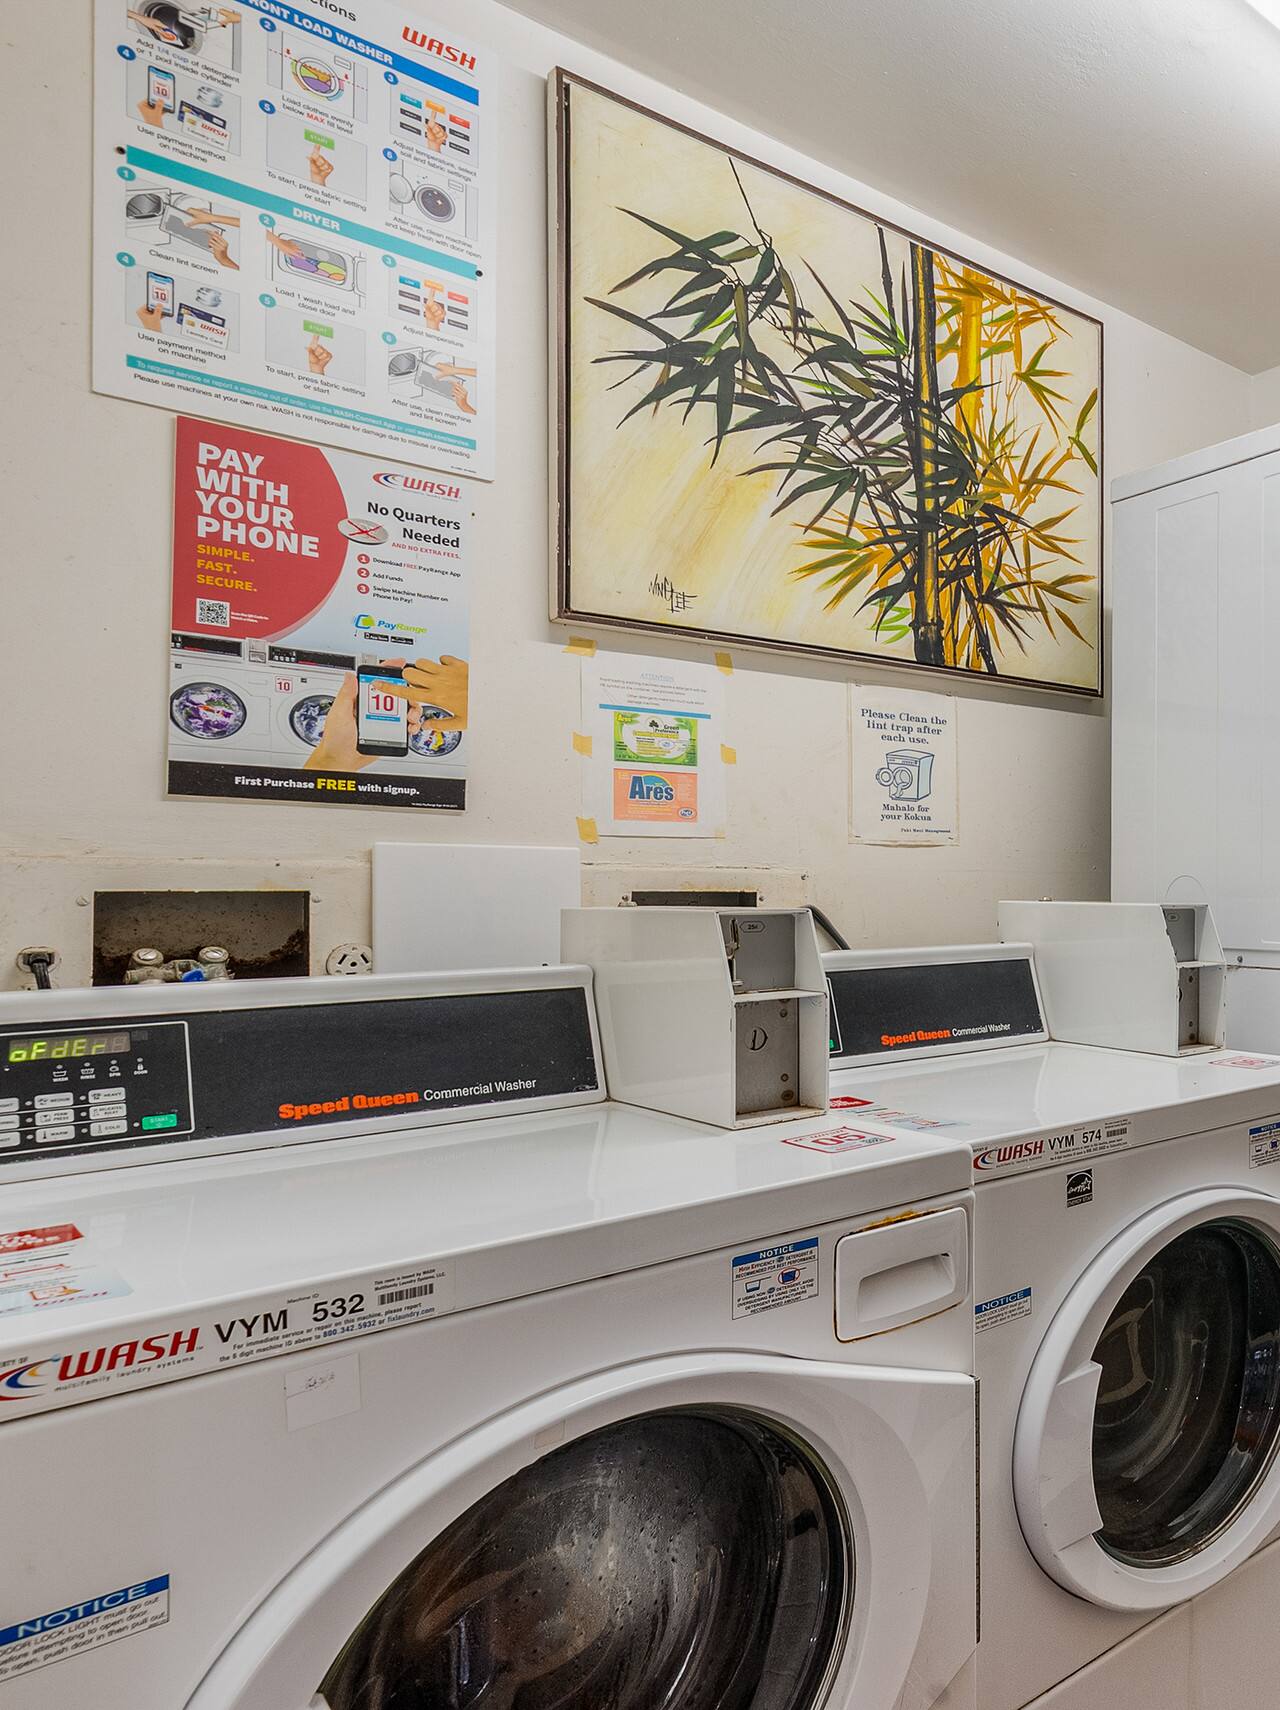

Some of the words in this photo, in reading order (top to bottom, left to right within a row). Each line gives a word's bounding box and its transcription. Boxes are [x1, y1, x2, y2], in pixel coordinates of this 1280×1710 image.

[249, 0, 290, 19] RONT
[293, 14, 332, 37] LOAD
[336, 31, 393, 65] WASHER
[402, 26, 476, 70] WASH
[200, 71, 232, 88] cylinder
[201, 62, 240, 83] detergent
[306, 112, 325, 124] MAX
[137, 125, 155, 137] Use
[157, 132, 192, 151] payment
[195, 145, 226, 161] method
[172, 146, 208, 163] machine
[321, 189, 340, 201] fabric
[343, 198, 367, 212] setting
[293, 207, 340, 231] DRYER
[149, 249, 174, 262] Clean
[191, 262, 219, 275] screen
[275, 287, 295, 299] Load
[138, 332, 155, 342] Use
[157, 338, 193, 354] payment
[195, 347, 226, 361] method
[403, 325, 422, 337] Adjust
[423, 331, 464, 348] temperature
[171, 350, 207, 364] machine
[297, 375, 319, 387] press
[320, 378, 340, 391] fabric
[341, 385, 366, 398] setting
[314, 385, 330, 395] start
[134, 373, 160, 385] Please
[177, 384, 212, 398] machines
[222, 395, 238, 405] your
[240, 400, 255, 408] own
[271, 405, 294, 417] WASH
[314, 417, 350, 431] responsible
[361, 428, 389, 440] damage
[408, 438, 429, 449] misuse
[392, 398, 408, 408] After
[425, 407, 443, 417] clean
[444, 412, 472, 424] machine
[435, 418, 457, 428] screen
[198, 441, 265, 476] PAY
[195, 466, 289, 506] WITH
[403, 476, 460, 499] WASH
[195, 490, 295, 531] YOUR
[367, 501, 389, 516] No
[393, 507, 461, 530] Quarters
[197, 515, 320, 559] PHONE
[402, 527, 460, 549] Needed
[196, 543, 255, 563] SIMPLE.
[391, 542, 406, 550] AND
[420, 547, 442, 557] EXTRA
[196, 559, 237, 574] FAST.
[373, 557, 403, 568] Download
[418, 565, 449, 576] PayRange
[196, 574, 257, 592] SECURE.
[385, 574, 404, 583] Funds
[373, 585, 391, 595] Swipe
[392, 588, 416, 598] Machine
[417, 592, 440, 602] Number
[373, 593, 392, 601] Phone
[378, 620, 428, 634] PayRange
[277, 680, 290, 692] 10
[371, 694, 395, 712] 10
[861, 708, 896, 720] Please
[900, 712, 927, 724] Clean
[931, 716, 947, 725] the
[866, 720, 887, 730] lint
[891, 723, 913, 735] trap
[917, 726, 942, 735] after
[881, 734, 906, 743] each
[909, 736, 929, 745] use.
[234, 776, 262, 787] First
[263, 778, 314, 790] Purchase
[316, 778, 356, 792] FREE
[358, 783, 381, 793] with
[383, 783, 420, 797] signup.
[629, 775, 674, 801] Ares
[880, 813, 902, 822] your
[904, 812, 932, 821] Kokua
[882, 803, 915, 812] Mahalo
[917, 804, 930, 812] for
[881, 1032, 917, 1046] Speed
[917, 1030, 950, 1041] Queen
[952, 1024, 988, 1037] Commercial
[989, 1023, 1011, 1033] Washer
[278, 1096, 350, 1120] Speed
[352, 1091, 419, 1109] Queen
[423, 1083, 493, 1101] Commercial
[494, 1079, 537, 1093] Washer
[996, 1140, 1044, 1162] WASH
[1048, 1134, 1075, 1151] VYM
[1082, 1128, 1102, 1144] 574
[759, 1244, 794, 1260] NOTICE
[735, 1267, 767, 1279] RECOMMENDED
[787, 1254, 816, 1265] PERFORMANCE
[982, 1291, 1024, 1311] NOTICE
[58, 1327, 200, 1381] WASH
[214, 1310, 288, 1343] VYM
[311, 1293, 365, 1322] 532
[232, 1342, 245, 1350] For
[246, 1335, 280, 1349] immediate
[282, 1330, 304, 1340] service
[314, 1323, 333, 1333] repair
[357, 1310, 383, 1322] machine,
[385, 1306, 403, 1317] please
[404, 1302, 422, 1312] report
[239, 1348, 254, 1359] digit
[256, 1343, 283, 1354] machine
[294, 1336, 313, 1345] above
[322, 1320, 377, 1338] 800.342.5932
[387, 1308, 435, 1323] fixlaundry.com
[54, 1374, 110, 1392] multifamily
[117, 1365, 151, 1378] laundry
[157, 1356, 195, 1369] systems
[17, 1583, 149, 1639] NOTICE
[35, 1630, 65, 1644] LOCK
[70, 1617, 101, 1633] LIGHT
[104, 1608, 127, 1620] must
[128, 1602, 142, 1613] go
[144, 1596, 160, 1606] out
[32, 1631, 86, 1655] attempting
[100, 1616, 125, 1632] open
[43, 1646, 69, 1661] push
[70, 1637, 94, 1650] door
[107, 1625, 130, 1637] then
[131, 1615, 148, 1630] pull
